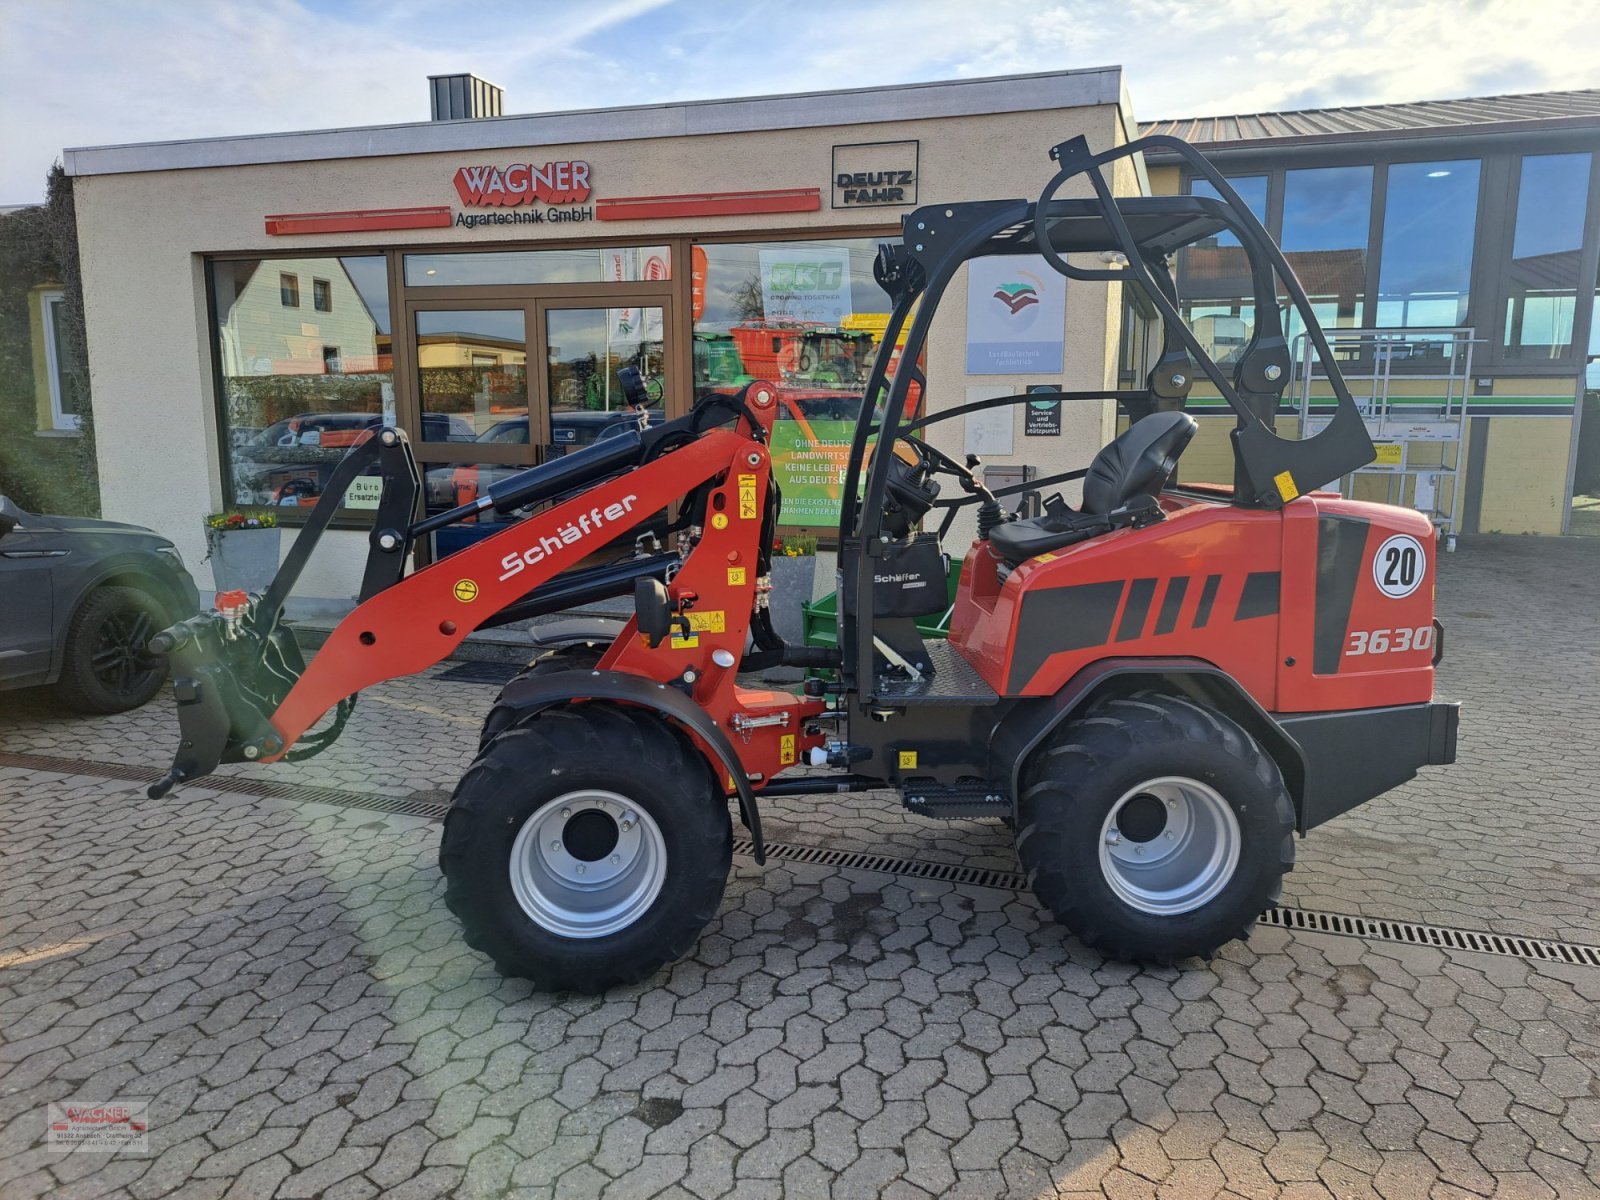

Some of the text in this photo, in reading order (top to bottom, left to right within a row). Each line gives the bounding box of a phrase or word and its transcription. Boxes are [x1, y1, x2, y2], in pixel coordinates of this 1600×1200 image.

[456, 160, 590, 199] WAGNER
[837, 170, 913, 188] DEUTZ
[843, 187, 904, 204] FAHR
[456, 206, 593, 229] Agrartechnik GmbH
[795, 440, 820, 449] OHNE
[785, 463, 848, 473] KEINE LEBENS
[789, 475, 839, 485] AUS DEUTS
[356, 483, 379, 491] Büro
[349, 493, 380, 502] Ersatztei
[808, 498, 841, 507] EXISTENZ
[499, 494, 637, 582] Schäffer
[1384, 547, 1417, 586] 20
[874, 573, 921, 583] Schäffer
[1345, 626, 1433, 656] 3630
